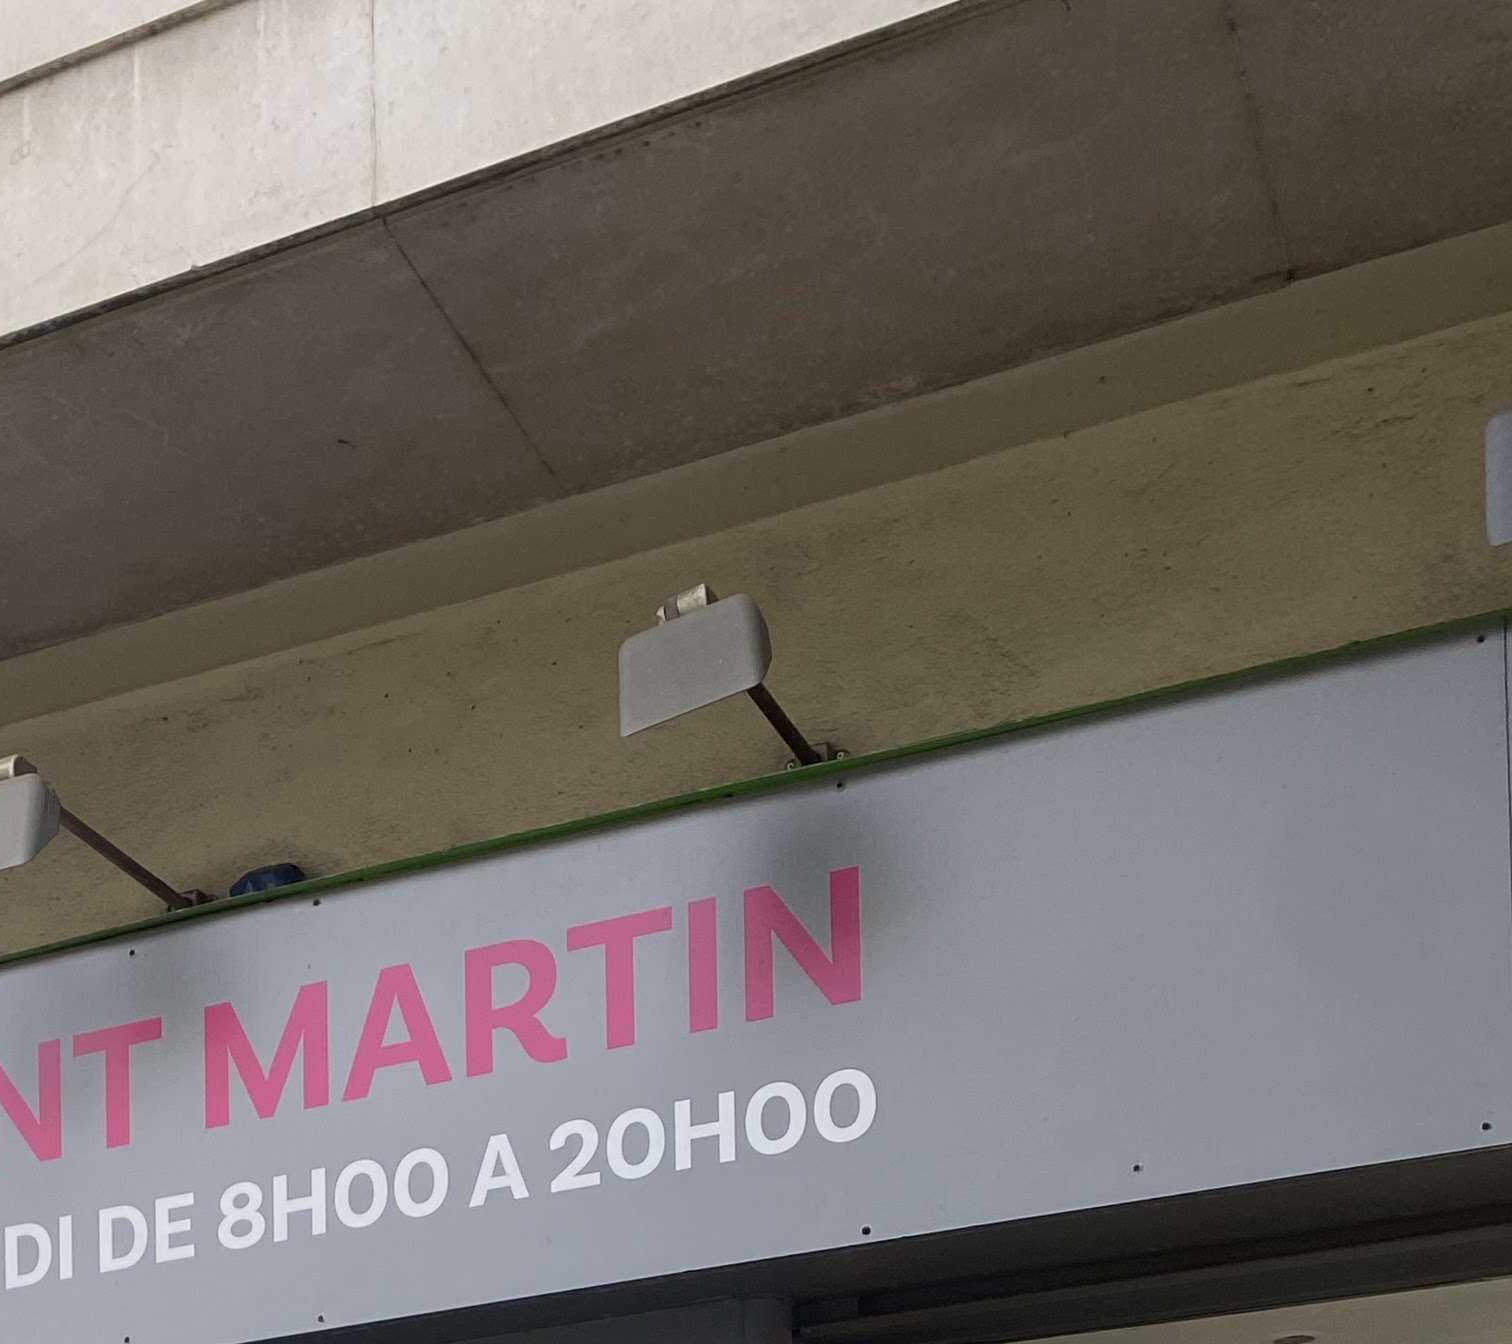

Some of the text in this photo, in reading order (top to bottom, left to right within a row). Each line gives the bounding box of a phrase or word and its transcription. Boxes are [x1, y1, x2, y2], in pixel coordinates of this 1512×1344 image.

[203, 865, 862, 1129] MARTIN
[98, 1191, 196, 1274] DE
[216, 1147, 449, 1250] 8H00
[469, 1133, 530, 1208] A
[549, 1067, 877, 1193] 20H00
